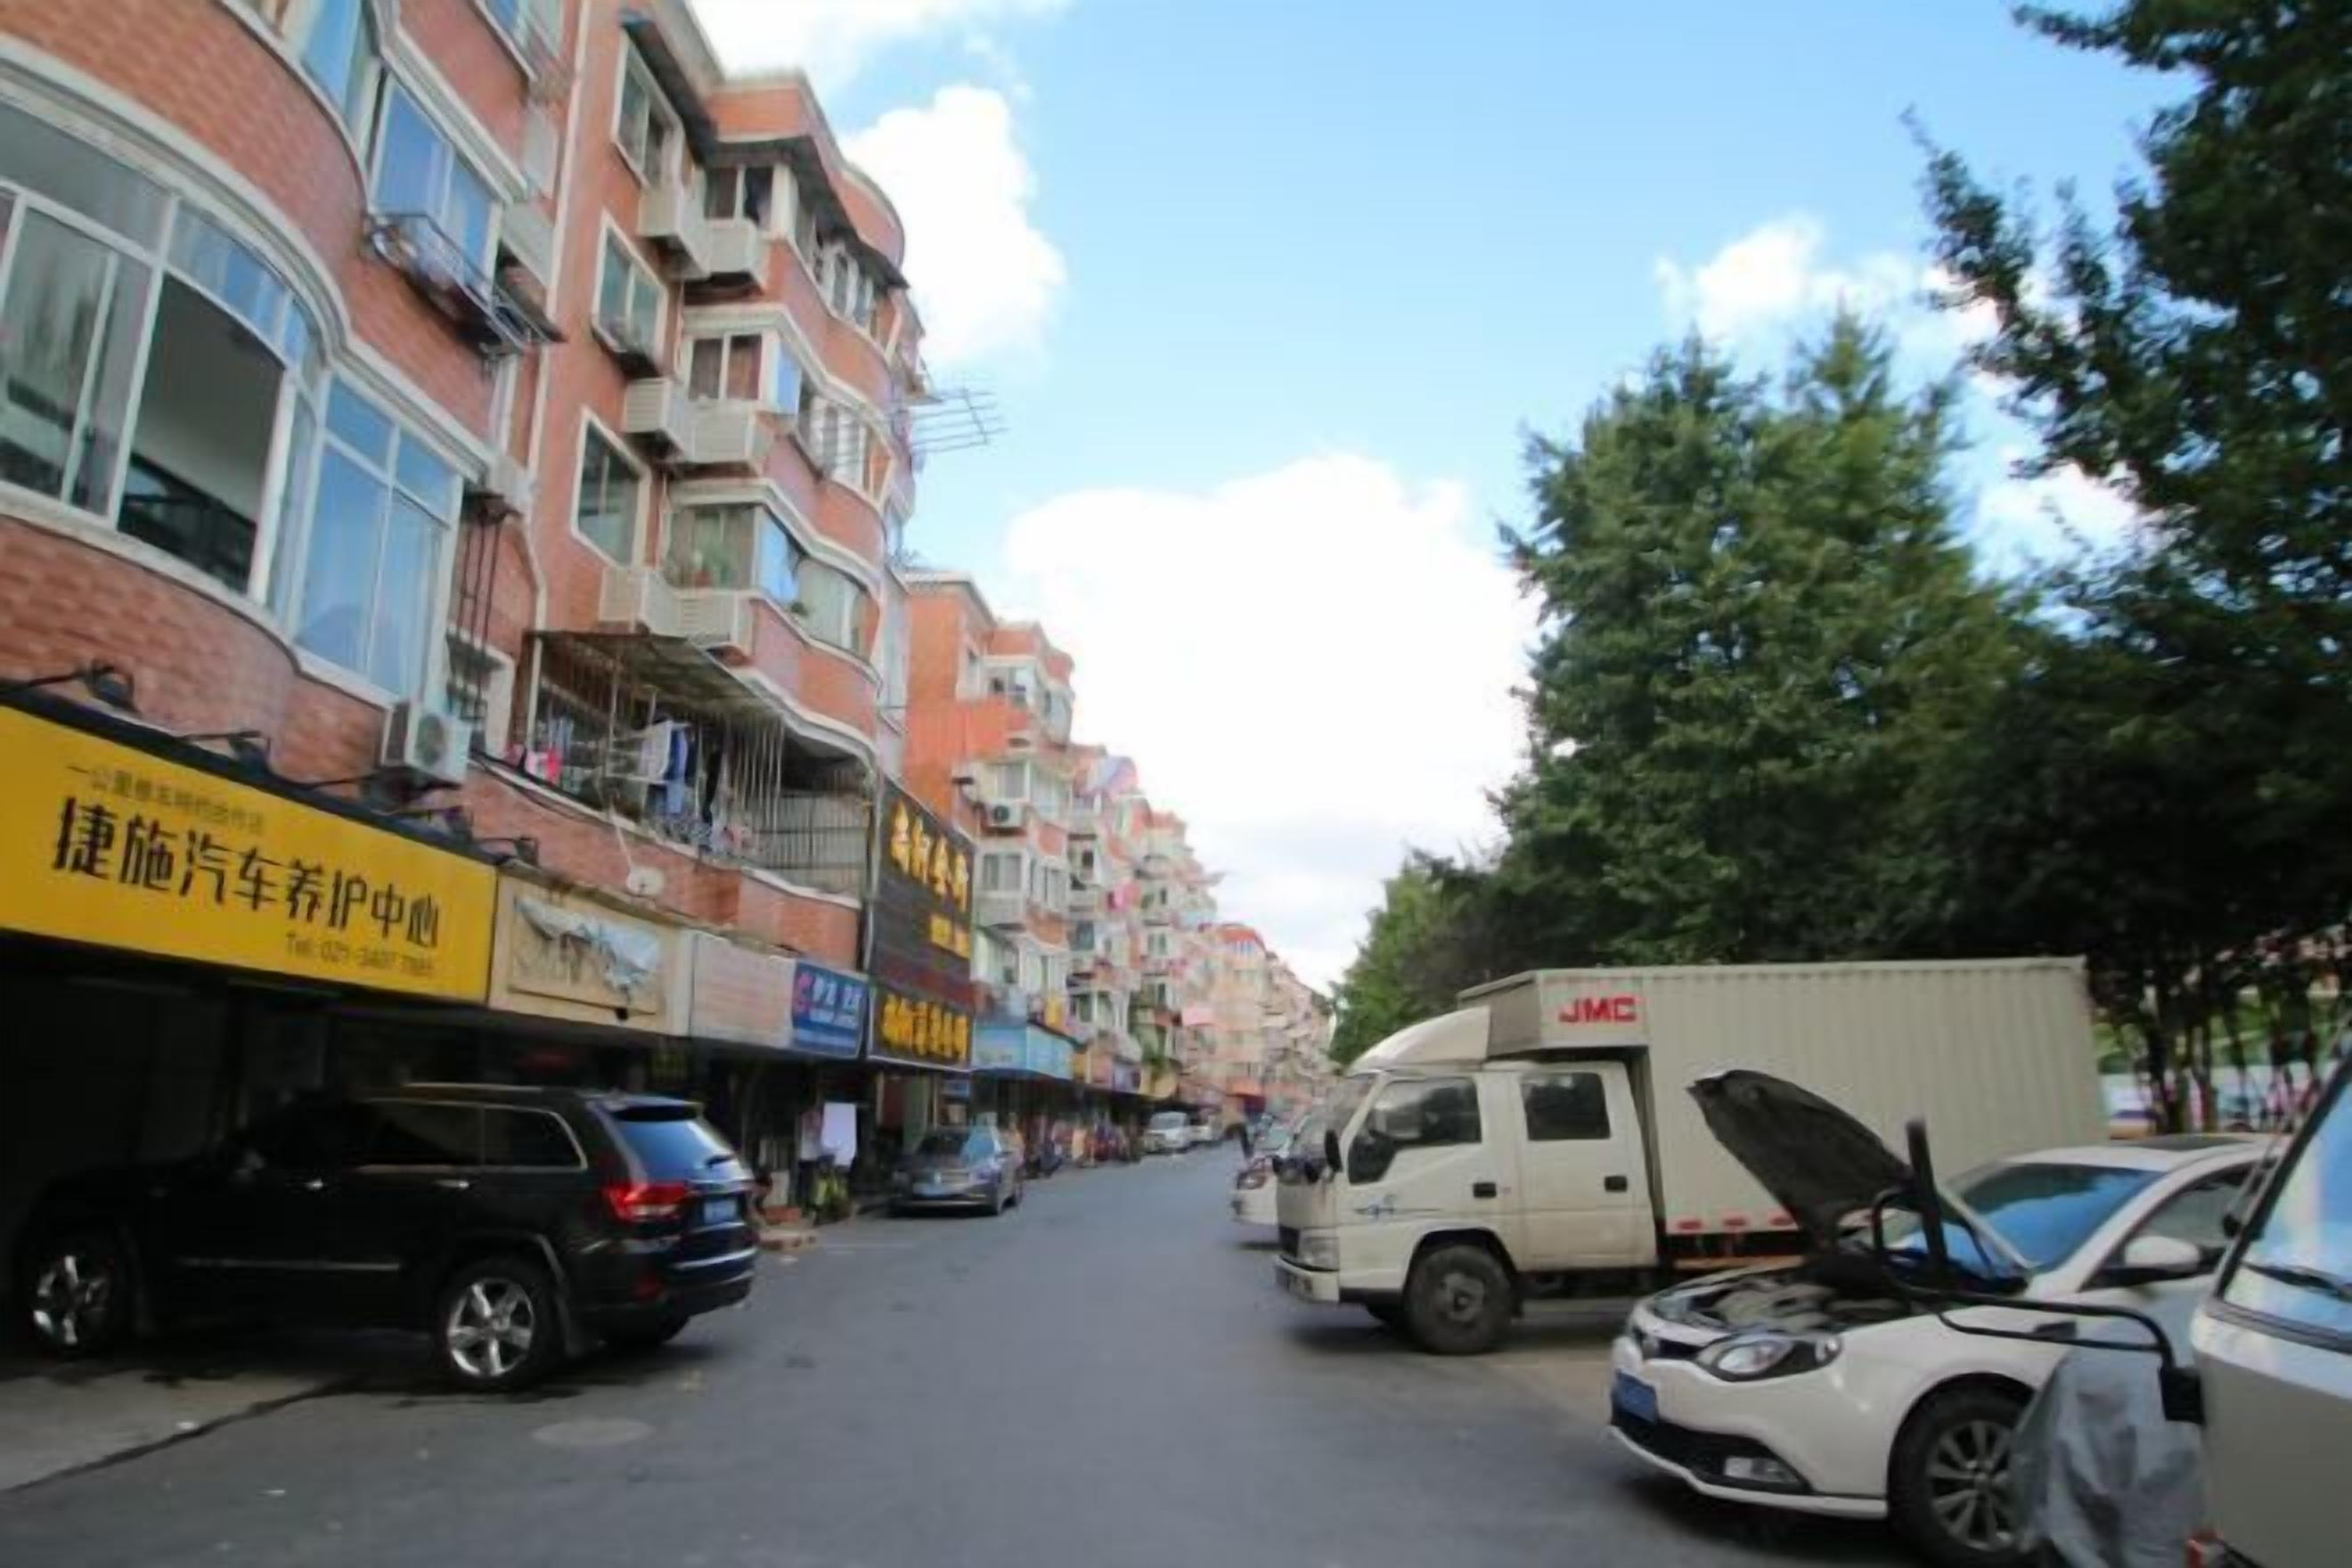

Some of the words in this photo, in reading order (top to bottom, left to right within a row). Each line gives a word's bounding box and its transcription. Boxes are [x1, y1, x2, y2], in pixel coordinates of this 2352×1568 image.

[53, 796, 440, 949] 捷施汽车养护中心
[1559, 997, 1637, 1023] JMC
